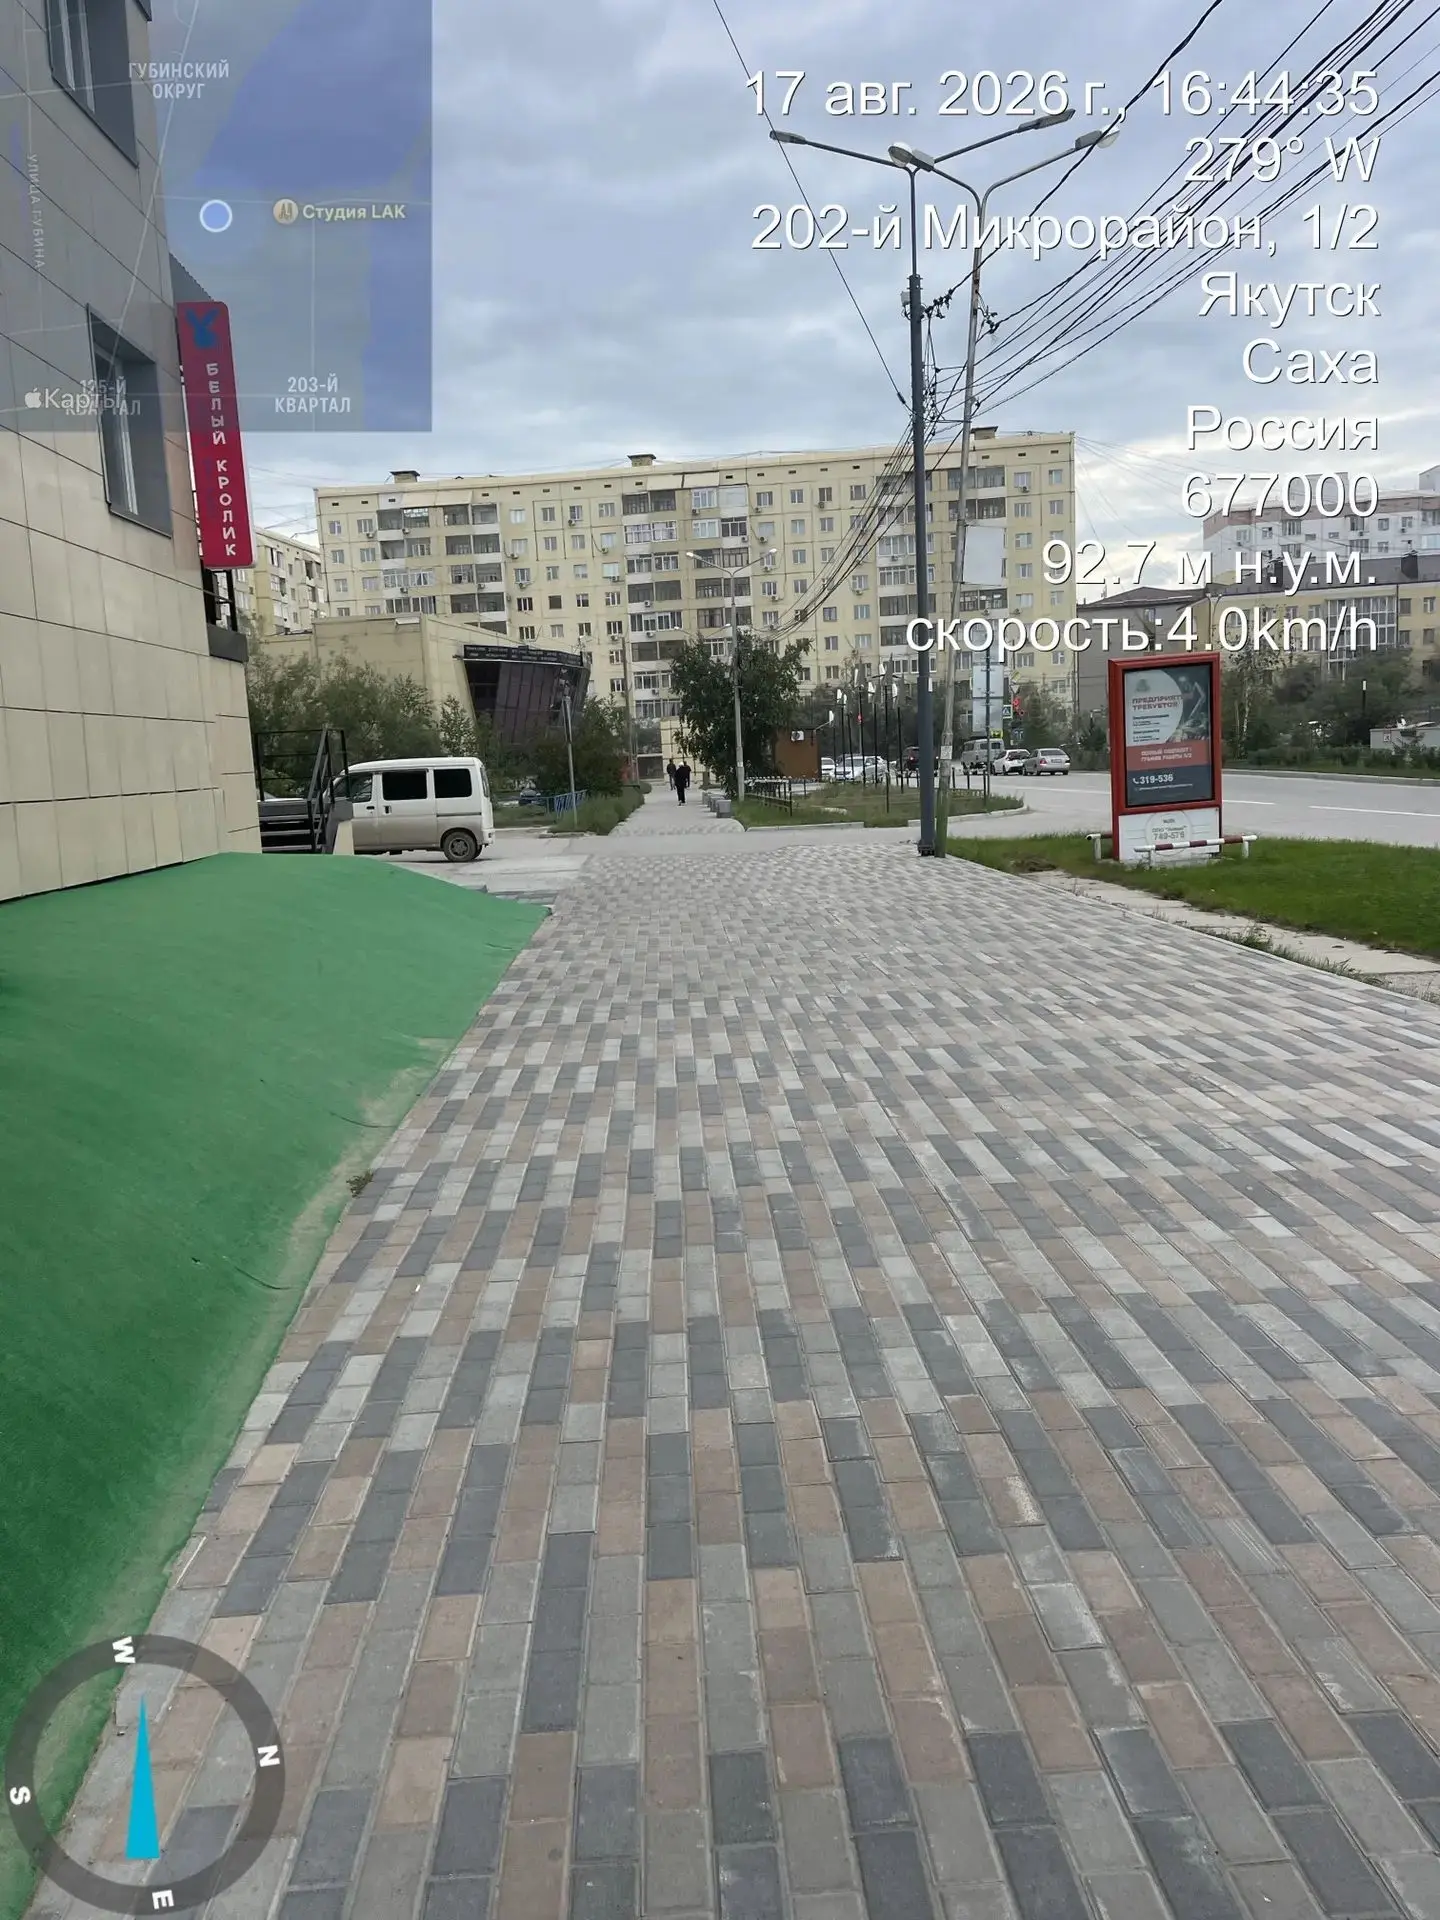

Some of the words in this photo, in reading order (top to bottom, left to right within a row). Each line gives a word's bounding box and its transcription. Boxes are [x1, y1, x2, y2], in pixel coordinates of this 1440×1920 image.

[205, 362, 227, 446] БЕЛЫЙ
[216, 459, 237, 557] КРОЛИК
[1139, 773, 1174, 785] 319-536
